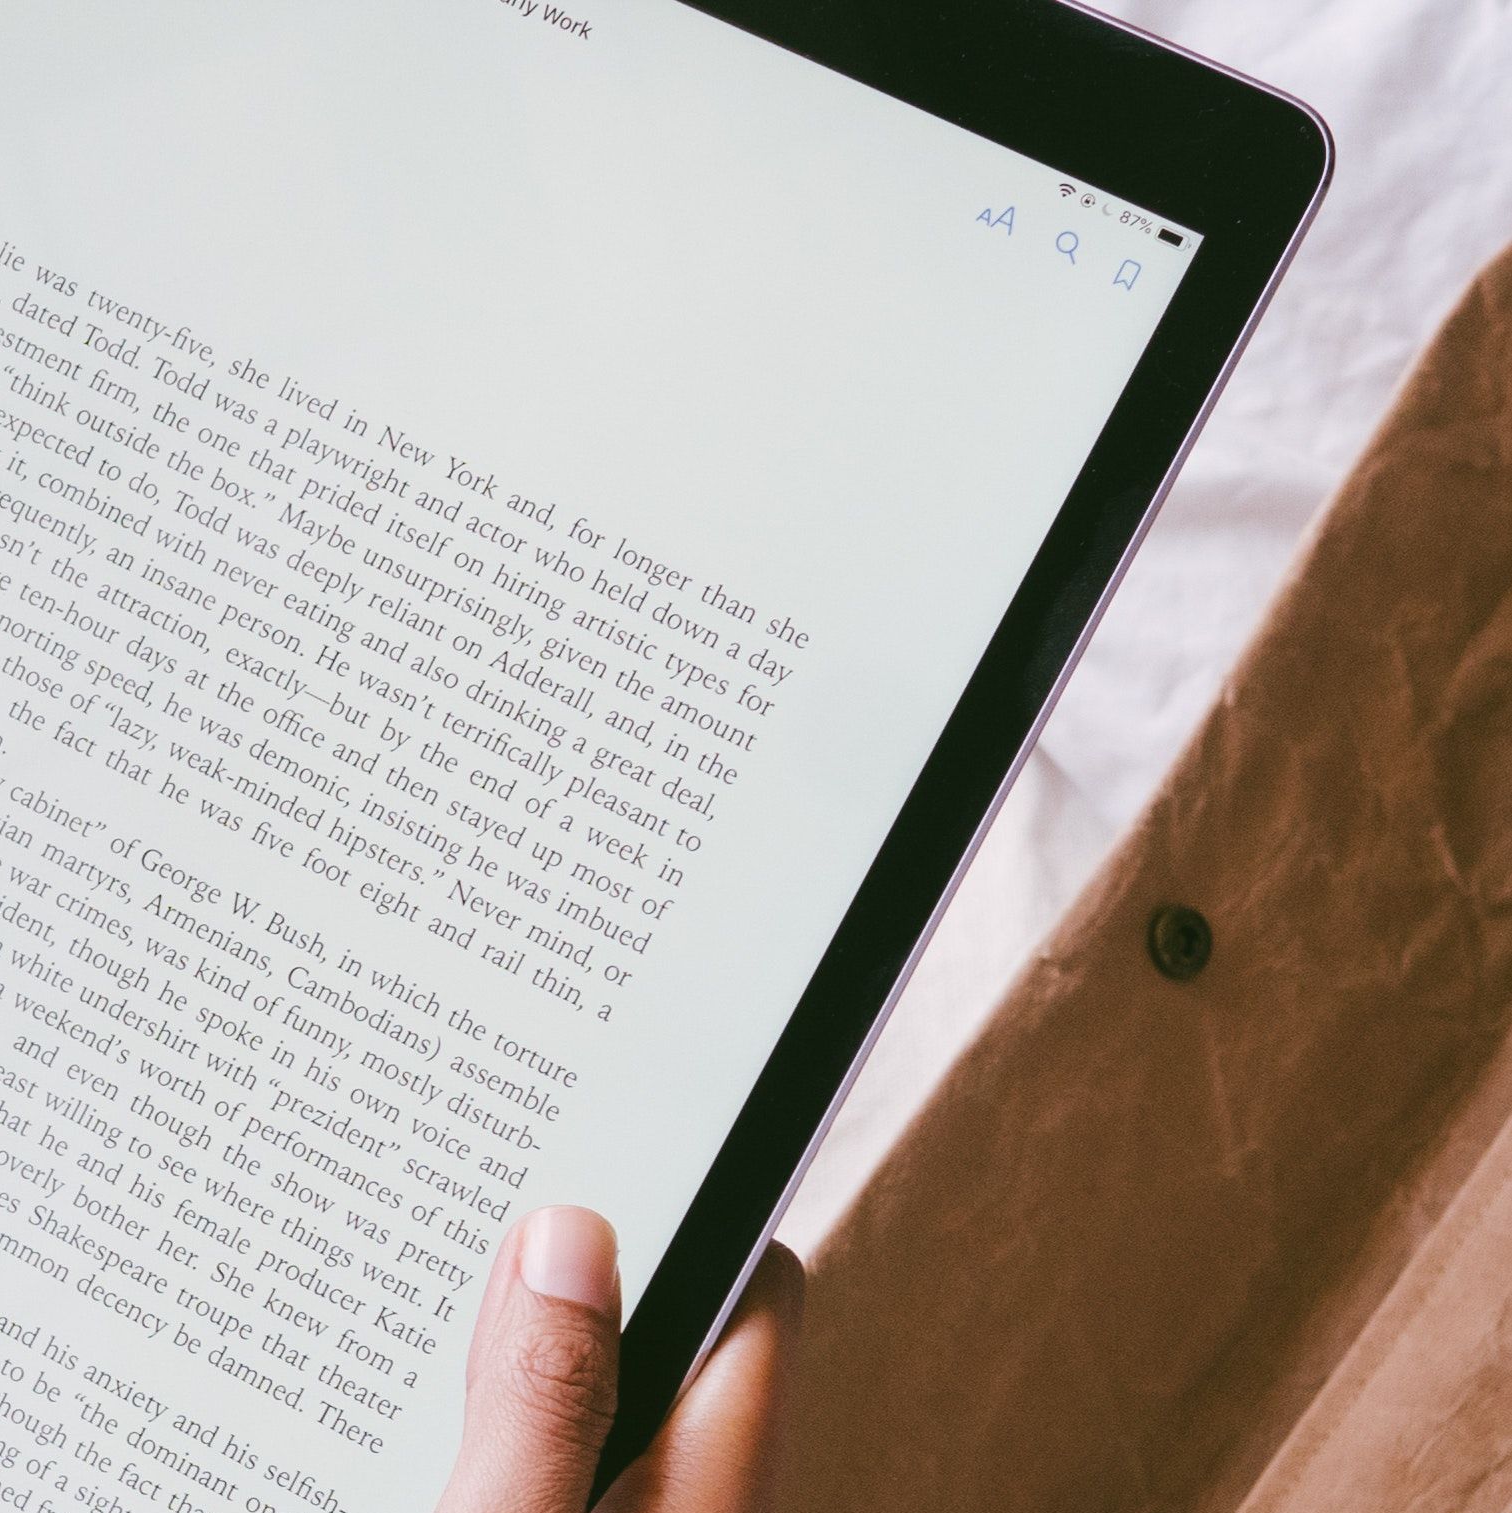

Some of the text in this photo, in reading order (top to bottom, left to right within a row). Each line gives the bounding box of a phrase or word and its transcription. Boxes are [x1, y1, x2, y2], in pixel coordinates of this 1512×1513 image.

[543, 3, 593, 40] Work
[1119, 210, 1153, 235] 87%
[3, 364, 72, 417] “think
[75, 409, 161, 460] outside
[166, 449, 205, 482] the
[209, 466, 277, 509] box.”
[276, 501, 356, 556] Maybe
[362, 547, 535, 648] unsurprisingly,
[538, 636, 608, 680] given
[614, 669, 655, 702] the
[659, 695, 758, 753] amount
[35, 265, 79, 297] was
[87, 289, 216, 369] twenty-five,
[227, 357, 270, 390] she
[276, 375, 340, 422] lived
[342, 408, 369, 438] in
[376, 424, 436, 468] New
[444, 455, 500, 501] York
[506, 493, 557, 533] and,
[566, 517, 607, 550] for
[611, 537, 694, 593] longer
[700, 583, 757, 625] than
[765, 616, 810, 650] she
[1, 655, 64, 700] those
[69, 693, 102, 715] of
[104, 701, 159, 752] “lazy,
[169, 741, 327, 832] weak-minded
[326, 816, 446, 886] hipsters.”
[446, 877, 523, 932] Never
[524, 924, 595, 974] mind,
[603, 964, 634, 988] or
[83, 659, 155, 709] speed,
[161, 691, 193, 724] he
[199, 714, 244, 749] was
[248, 738, 350, 809] demonic,
[358, 792, 465, 866] insisting
[465, 844, 499, 879] he
[506, 870, 552, 905] was
[554, 891, 654, 956] imbued
[105, 547, 136, 572] an
[139, 557, 217, 611] insane
[216, 603, 305, 657] person.
[313, 643, 351, 678] He
[358, 669, 437, 721] wasn’t
[441, 711, 565, 787] terrifically
[562, 775, 671, 838] pleasant
[675, 827, 702, 853] to
[9, 785, 108, 839] cabinet”
[109, 837, 143, 860] of
[140, 848, 222, 905] George
[232, 890, 262, 925] W.
[264, 910, 327, 965] Bush,
[336, 948, 363, 979] in
[370, 969, 441, 1019] which
[447, 1008, 487, 1042] the
[493, 1033, 578, 1089] torture
[40, 842, 132, 905] martyrs,
[141, 893, 273, 979] Armenians,
[287, 966, 442, 1063] Cambodians)
[449, 1055, 560, 1122] assemble
[10, 948, 74, 994] white
[78, 985, 201, 1061] undershirt
[206, 1051, 258, 1092] with
[268, 1077, 402, 1159] “prezident”
[401, 1158, 512, 1224] scrawled
[27, 1204, 168, 1295] Shakespeare
[175, 1287, 254, 1341] troupe
[261, 1332, 311, 1372] that
[317, 1363, 404, 1421] theater
